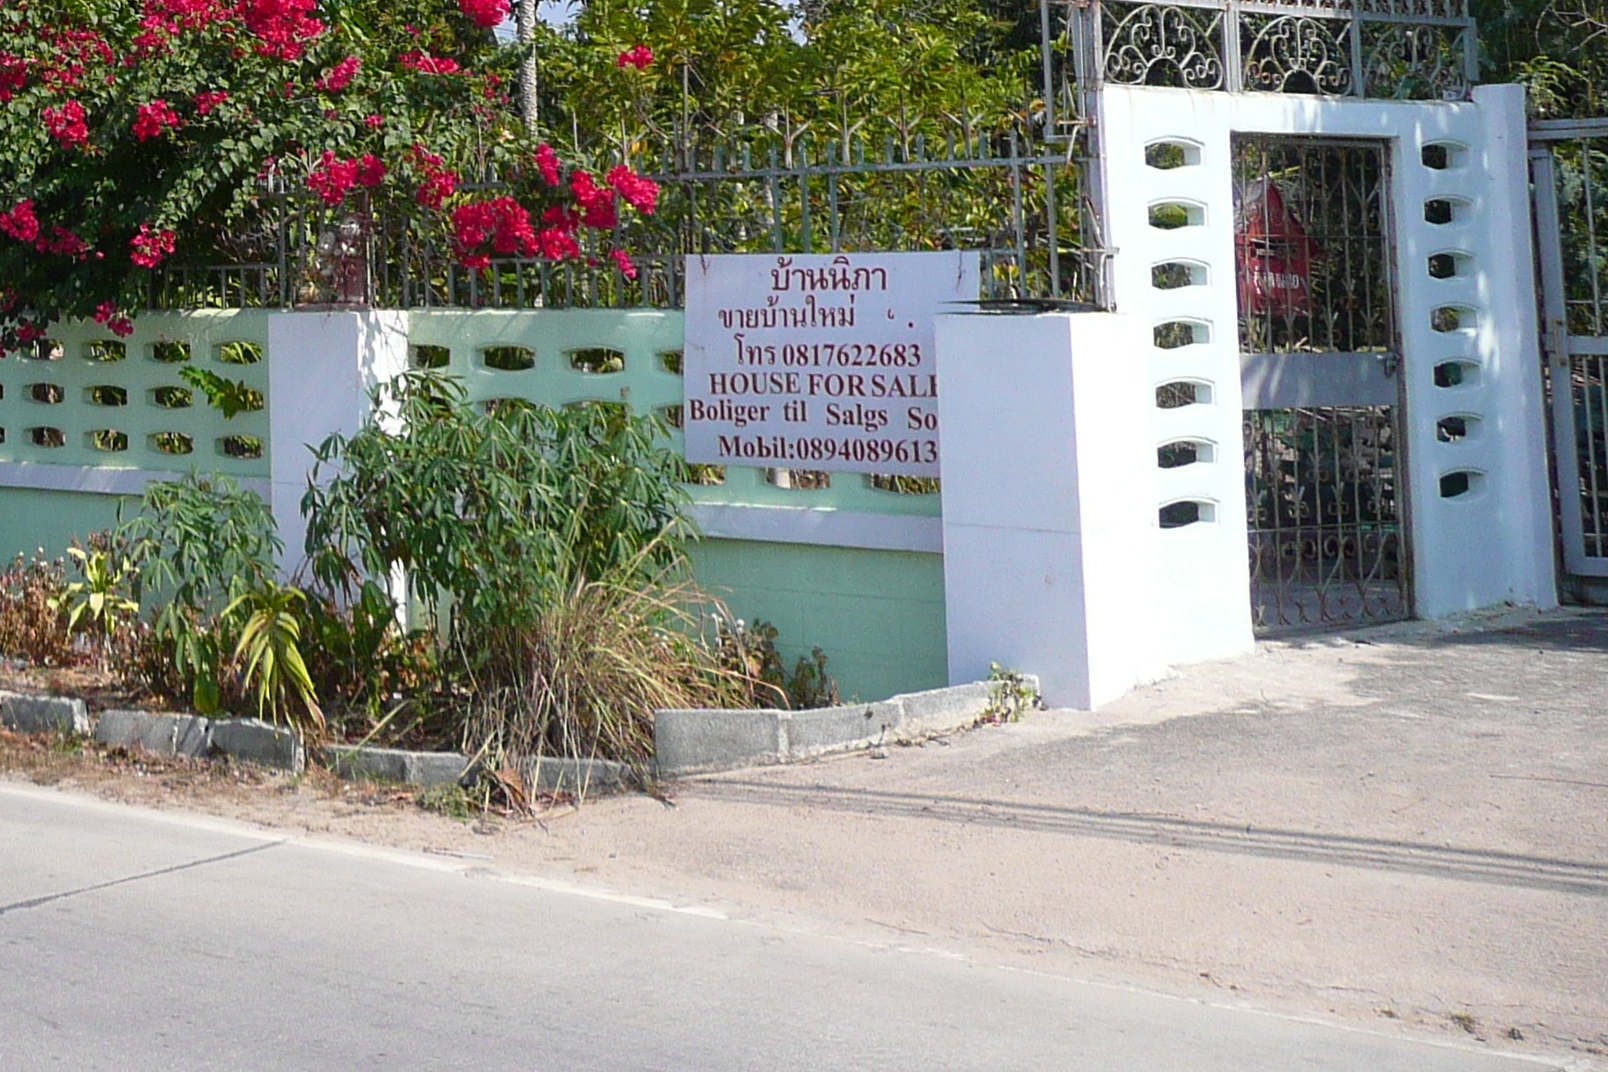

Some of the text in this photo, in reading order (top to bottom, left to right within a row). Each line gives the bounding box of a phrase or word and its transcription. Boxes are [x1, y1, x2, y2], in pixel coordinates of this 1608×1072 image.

[771, 256, 887, 291] บ้านนิภา
[718, 294, 855, 329] ขายบ้านใหม่
[733, 333, 921, 367] โทร 0817622683
[709, 373, 800, 395] HOUSE
[807, 374, 866, 397] FOR
[689, 399, 770, 427] Boliger
[783, 400, 807, 423] til
[826, 403, 888, 432] Salgs
